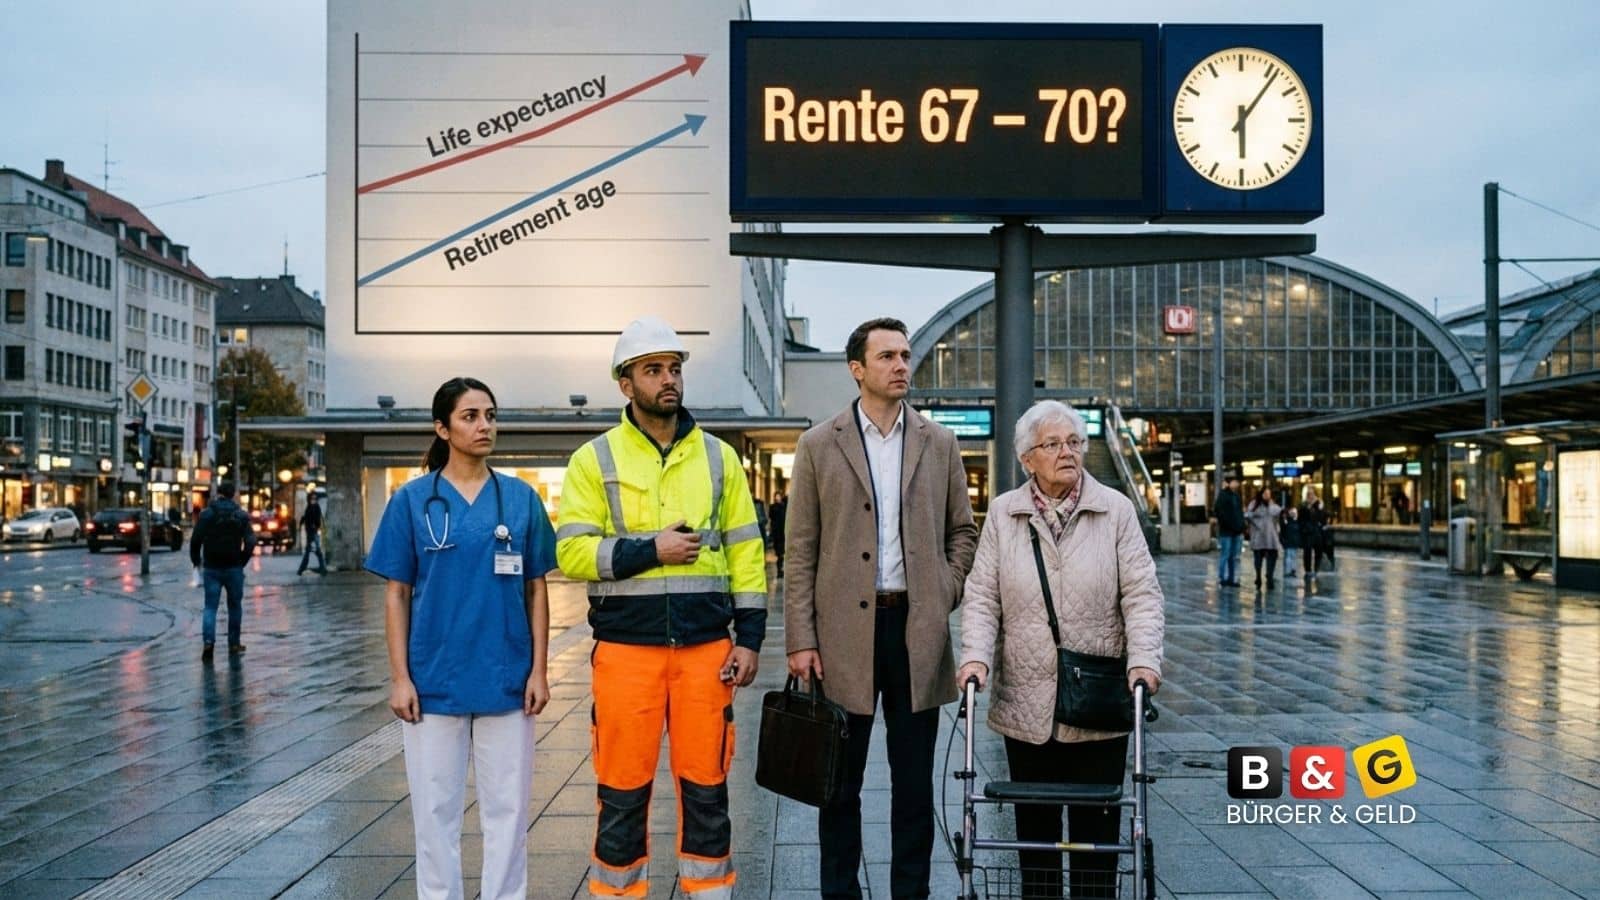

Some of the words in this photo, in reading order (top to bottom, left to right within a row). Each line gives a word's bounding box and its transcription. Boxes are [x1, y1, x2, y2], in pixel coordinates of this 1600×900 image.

[426, 126, 472, 158] Life
[476, 75, 607, 138] expectancy
[764, 87, 905, 143] Rente
[919, 87, 980, 143] 67
[1038, 87, 1128, 143] 70?
[443, 198, 571, 271] Retirement
[574, 179, 617, 210] age
